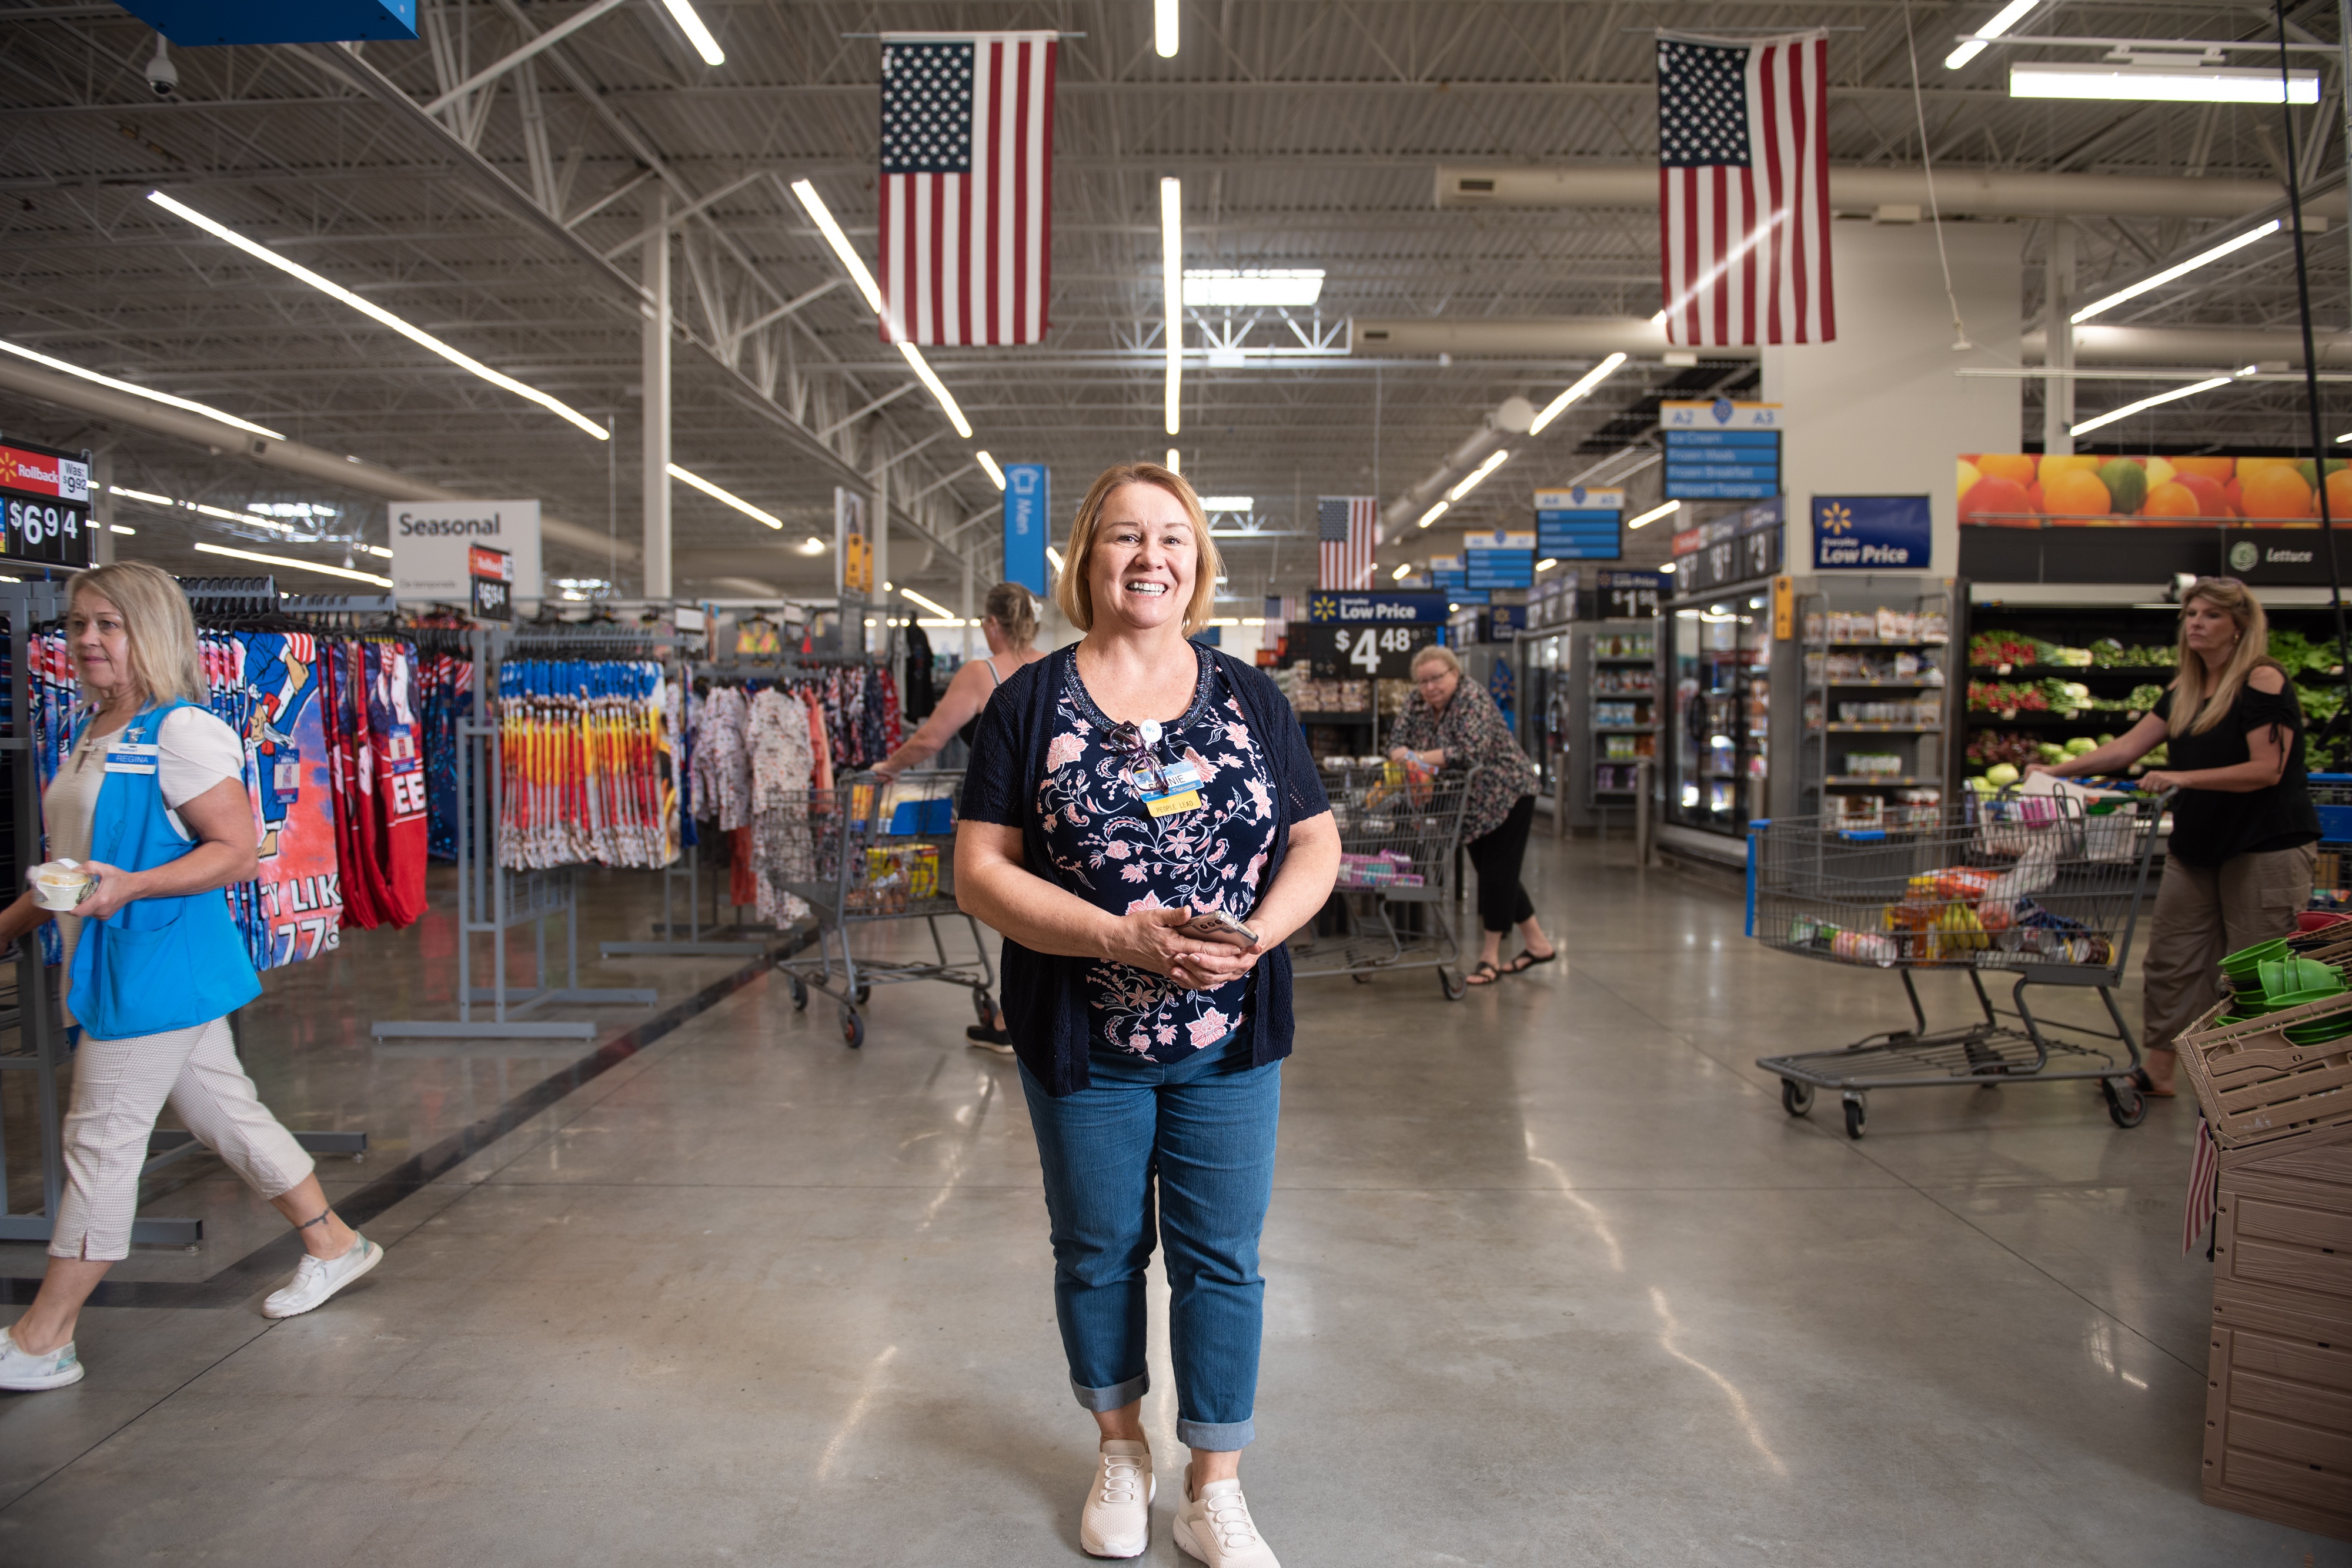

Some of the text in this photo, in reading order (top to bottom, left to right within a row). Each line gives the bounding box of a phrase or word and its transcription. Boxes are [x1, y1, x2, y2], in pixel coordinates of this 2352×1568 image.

[1672, 410, 1775, 425] A2 A3
[1686, 432, 1722, 442] Cream
[1669, 448, 1703, 460] Frozen
[18, 463, 59, 484] Rollback
[65, 462, 85, 477] Was:
[1669, 465, 1754, 478] Frozen Breakfast
[62, 474, 86, 493] $992
[9, 500, 78, 545] $694
[399, 511, 502, 537] Seasonal
[1821, 536, 1859, 548] Everyday
[1819, 544, 1909, 564] Low Price
[2266, 547, 2314, 563] Lettuce
[477, 556, 502, 574] Rollback
[479, 582, 506, 610] $694
[1339, 597, 1369, 606] Everyday
[1339, 603, 1416, 620] Low Price
[1335, 628, 1411, 674] $448
[116, 755, 149, 764] REGINA
[392, 772, 426, 815] EE
[1172, 783, 1196, 793] Difference
[1156, 800, 1194, 813] PEOPLE LEAD
[269, 914, 340, 969] 776
